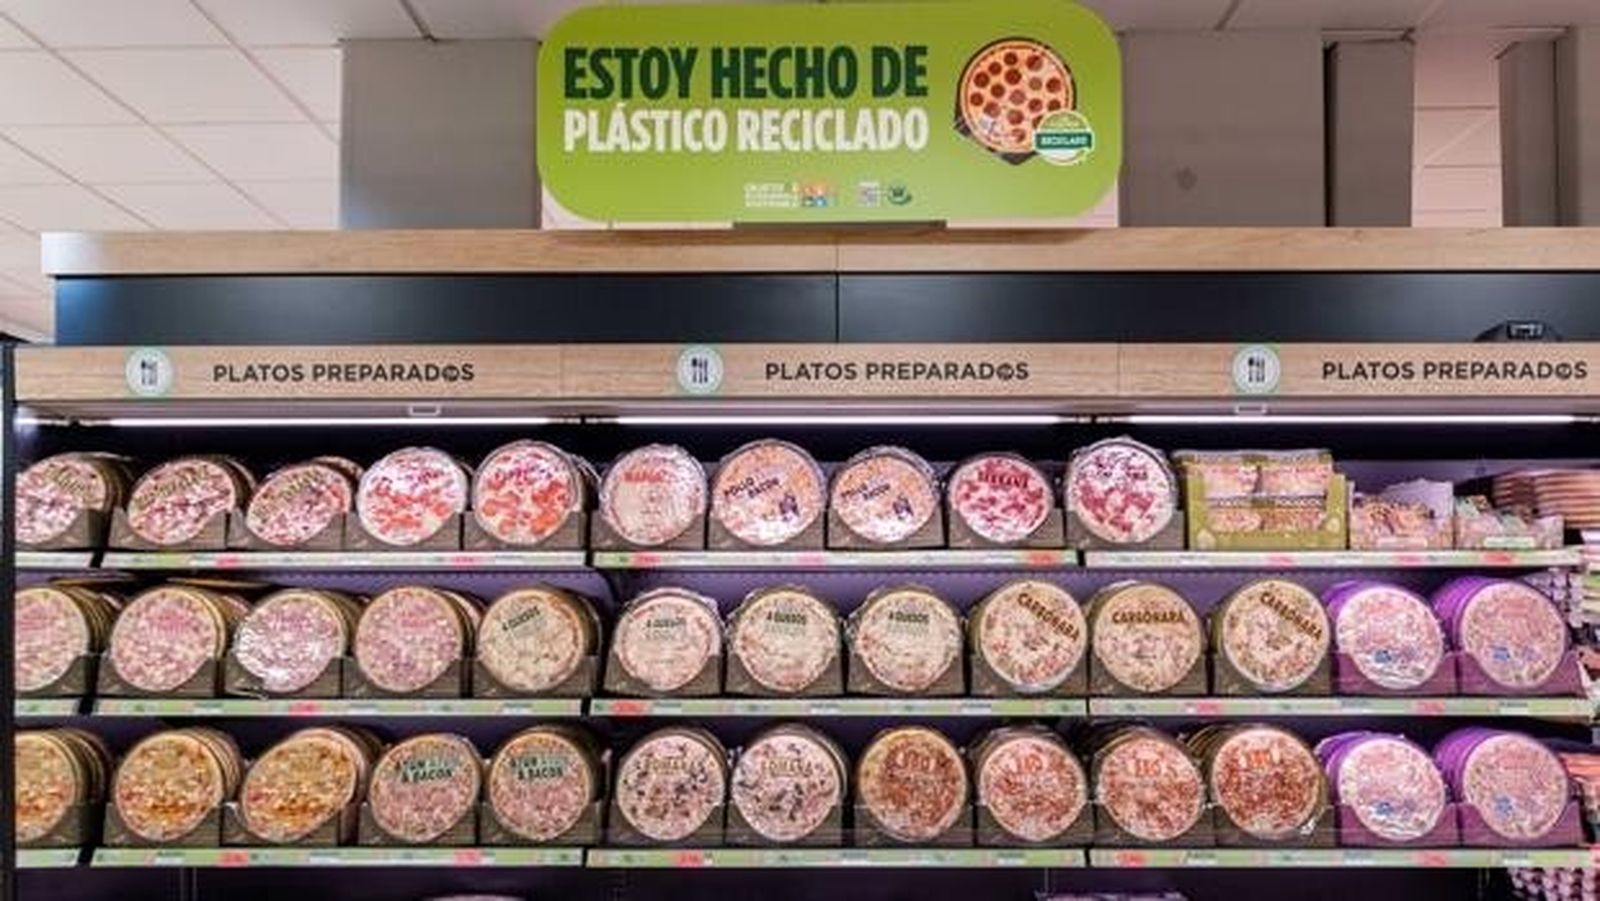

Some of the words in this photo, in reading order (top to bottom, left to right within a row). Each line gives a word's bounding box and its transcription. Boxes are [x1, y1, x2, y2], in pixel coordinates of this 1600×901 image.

[564, 46, 698, 100] ESTOY
[712, 46, 858, 100] HECHO
[871, 45, 929, 99] DE
[564, 102, 727, 153] PLÁSTICO
[738, 108, 929, 153] RECICLADO
[213, 363, 305, 382] PLATOS
[312, 363, 475, 382] PREPARADOS
[765, 363, 858, 380] PLATOS
[865, 363, 1030, 380] PREPARADOS
[1322, 362, 1414, 380] PLATOS
[1423, 362, 1588, 380] PREPARADOS
[1017, 593, 1080, 640] CARBONARA
[1112, 610, 1188, 624] CARBONARA
[1260, 593, 1323, 640] CARBONARA
